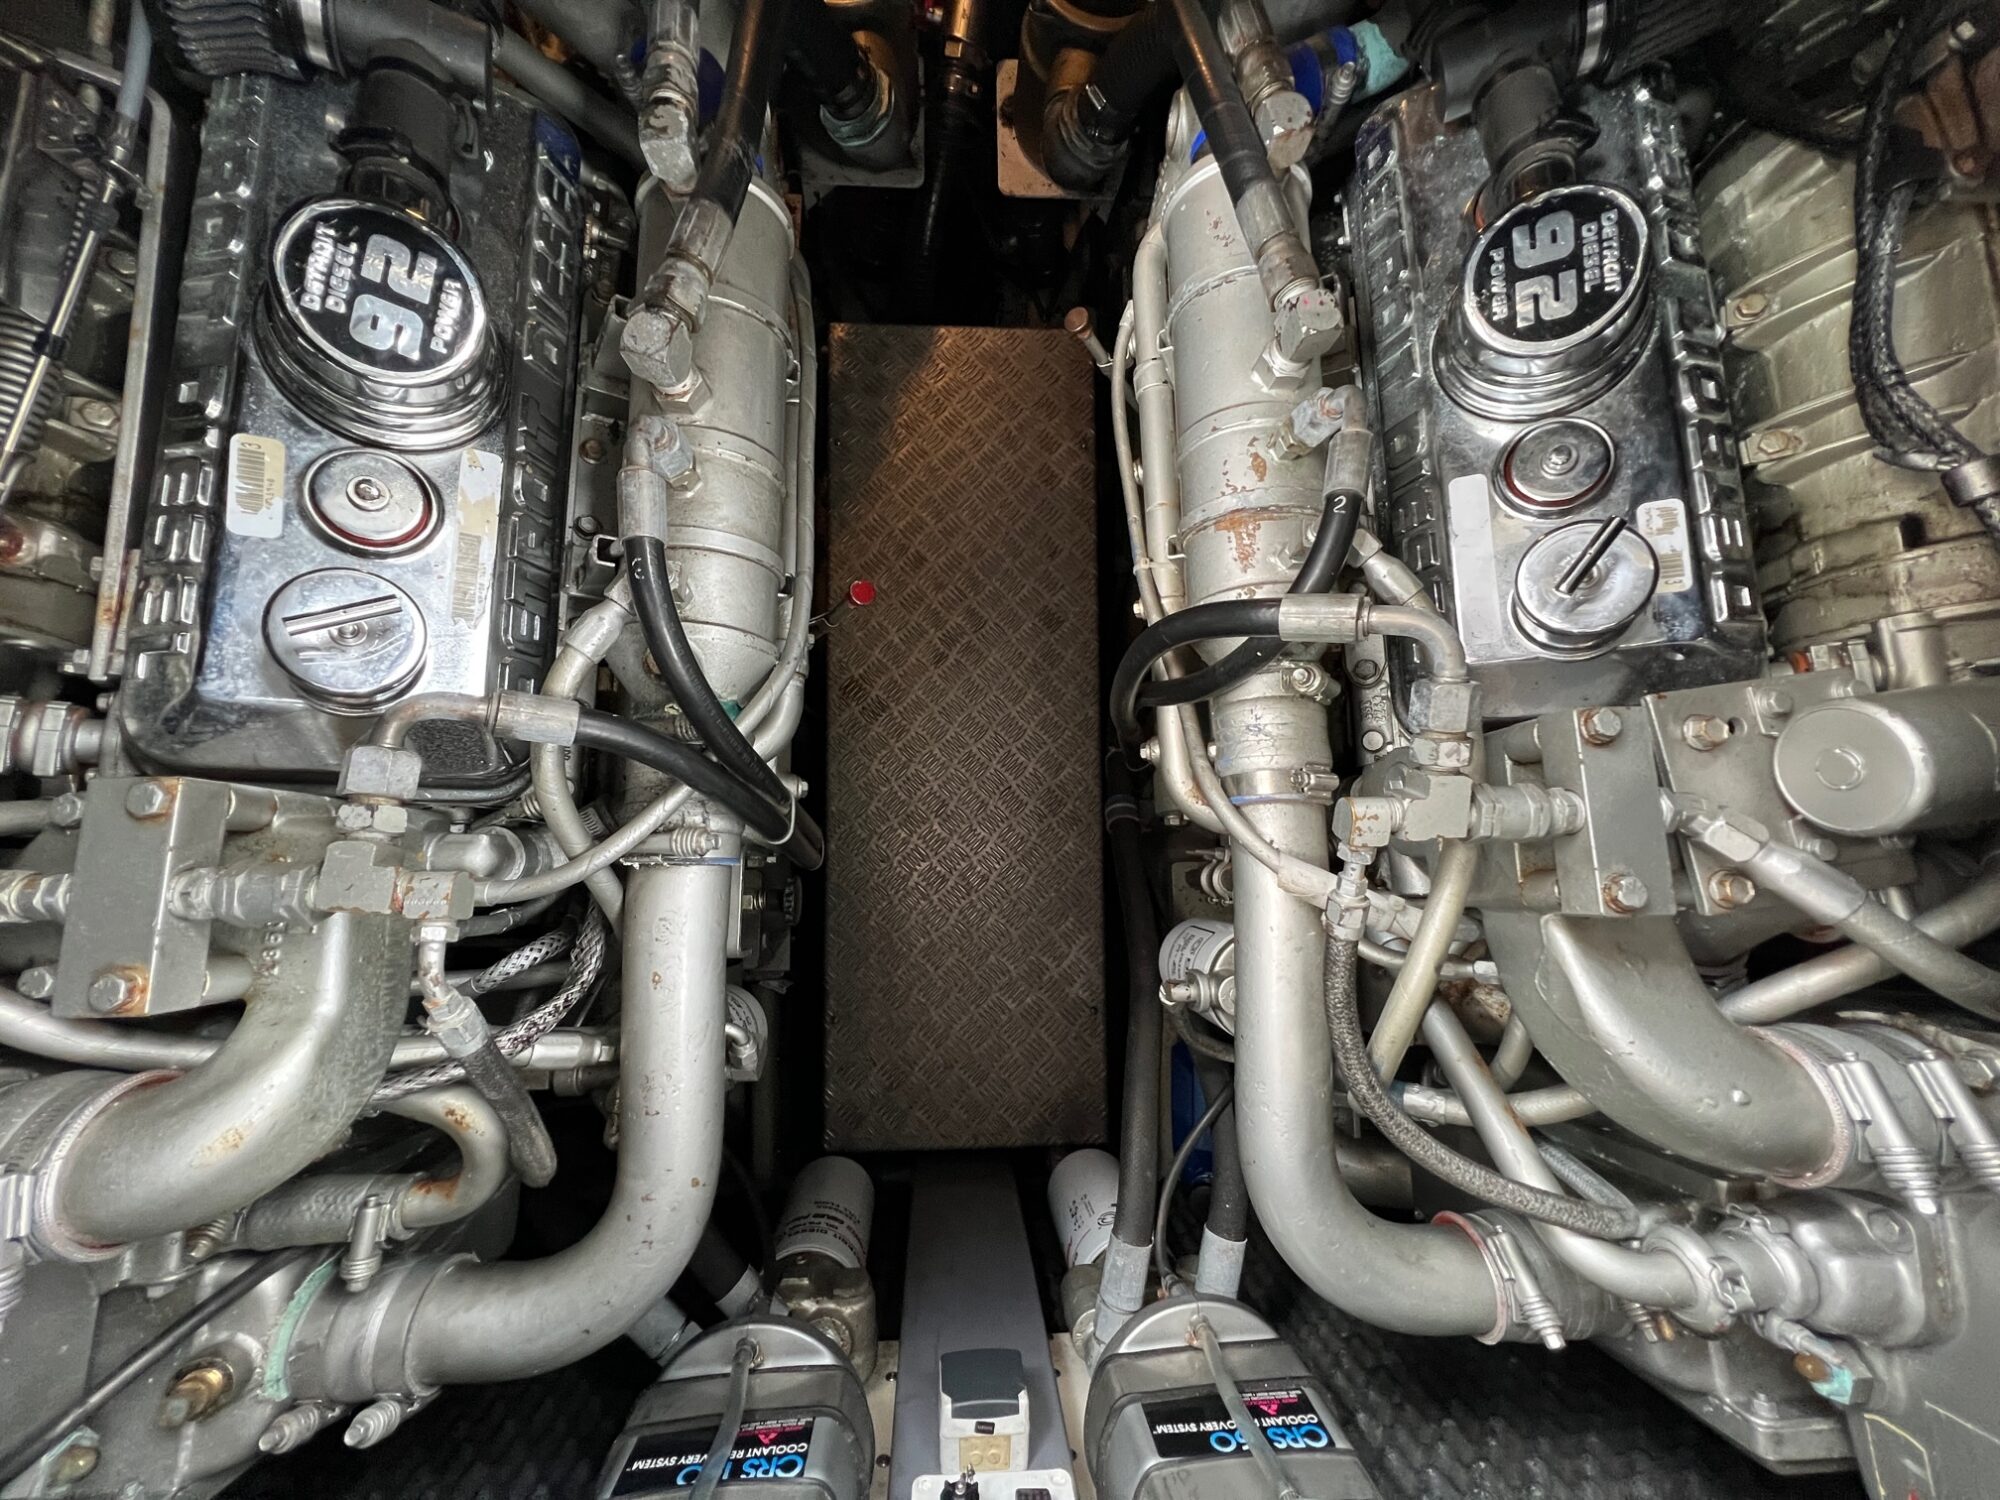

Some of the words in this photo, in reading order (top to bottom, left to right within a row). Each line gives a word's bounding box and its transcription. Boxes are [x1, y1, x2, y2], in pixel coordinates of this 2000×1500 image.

[300, 221, 337, 311] DETROIT
[325, 242, 358, 313] DIESEL
[1489, 247, 1509, 321] POWER
[1512, 210, 1578, 328] 92
[1581, 221, 1601, 294] DIESEL
[1601, 208, 1622, 292] DETROIT
[350, 234, 437, 360] 92
[430, 278, 462, 354] POWER
[1333, 495, 1347, 514] 2
[746, 1443, 808, 1459] COOLANT
[1260, 1414, 1318, 1427] COOLANT
[1267, 1425, 1328, 1449] CRS
[680, 1450, 745, 1466] REVERY
[741, 1455, 804, 1479] CRS
